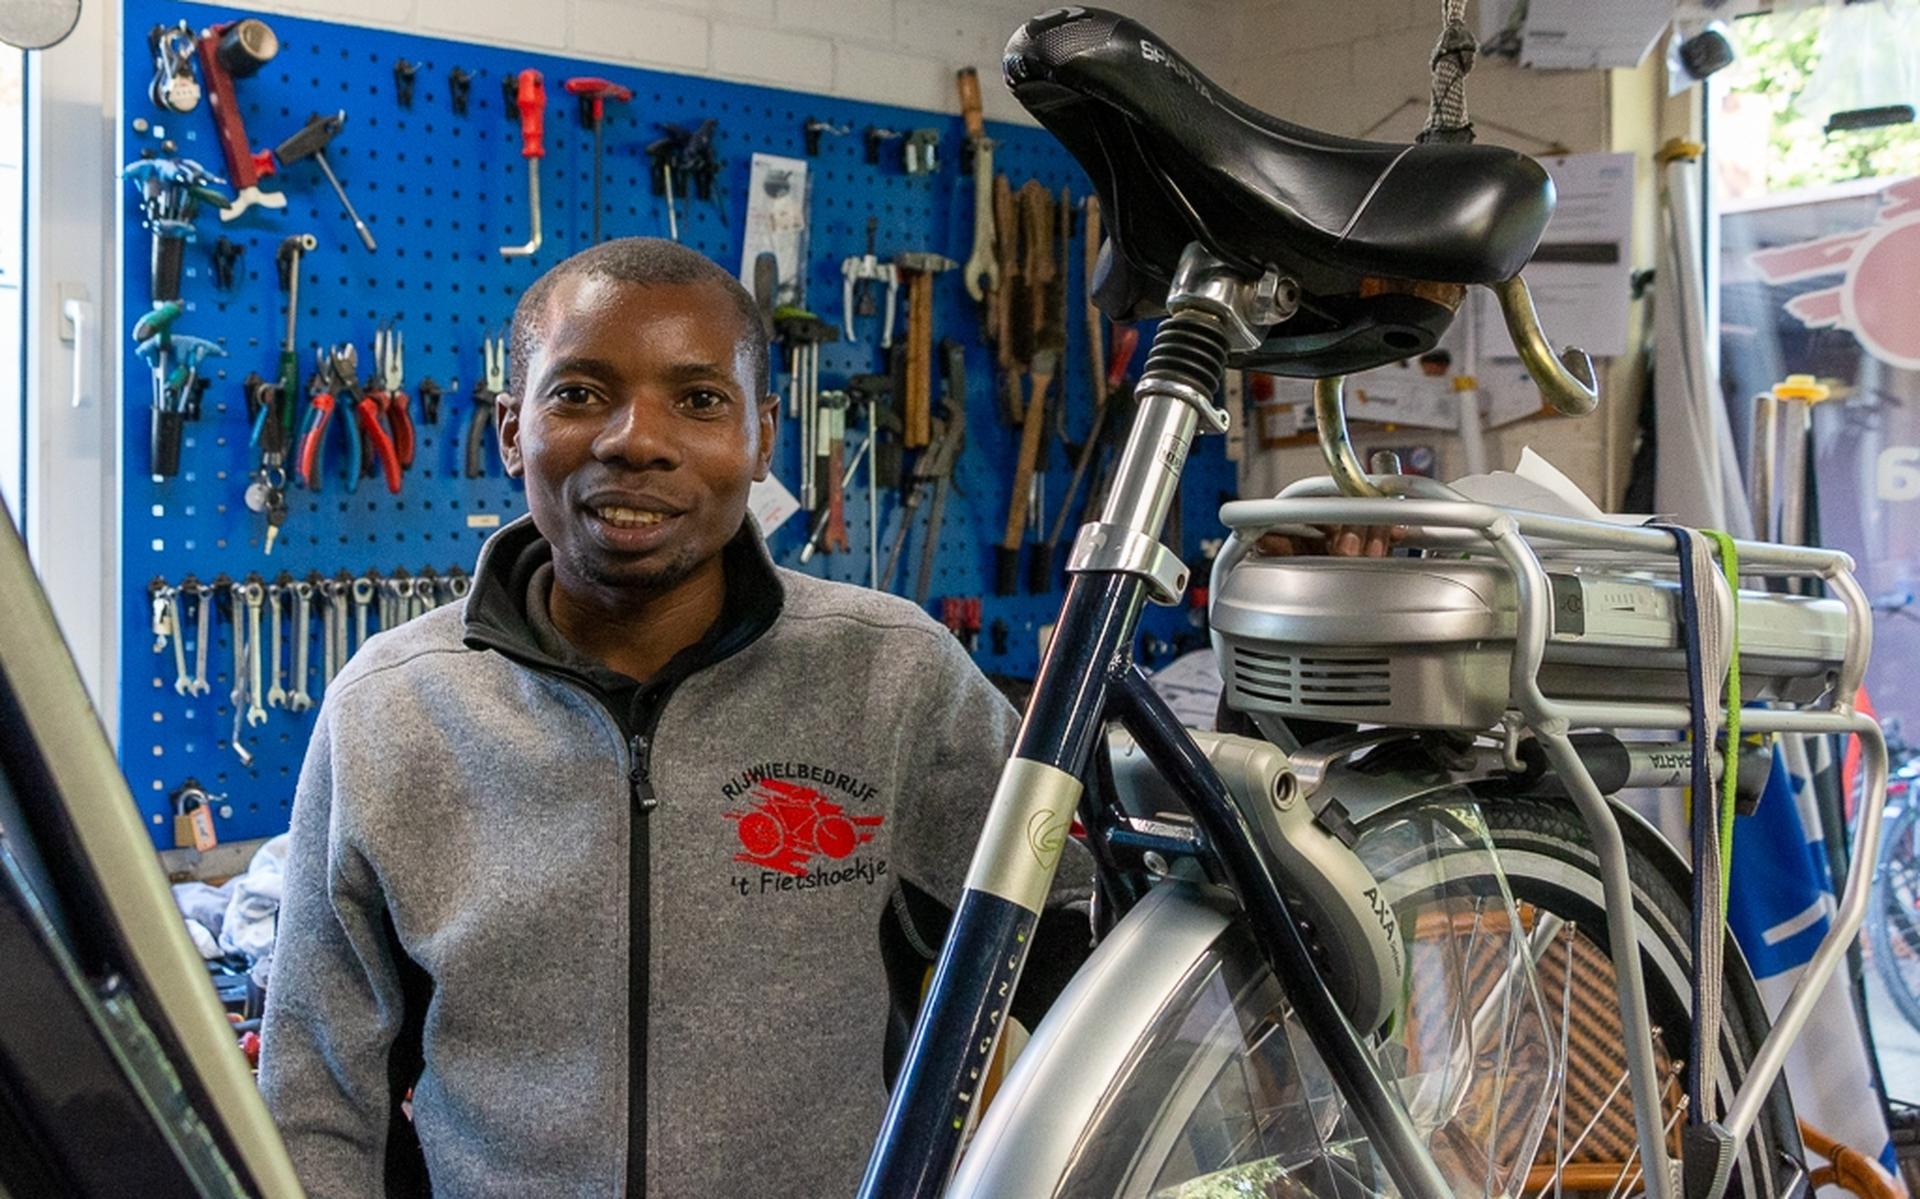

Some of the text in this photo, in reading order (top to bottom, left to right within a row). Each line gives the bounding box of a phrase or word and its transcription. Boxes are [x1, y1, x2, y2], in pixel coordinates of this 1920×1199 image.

[1649, 754, 1692, 769] PARTA
[721, 762, 878, 801] RIJWIELBEDRIJF
[760, 857, 887, 894] Fietshoekje
[1363, 887, 1394, 940] AXA
